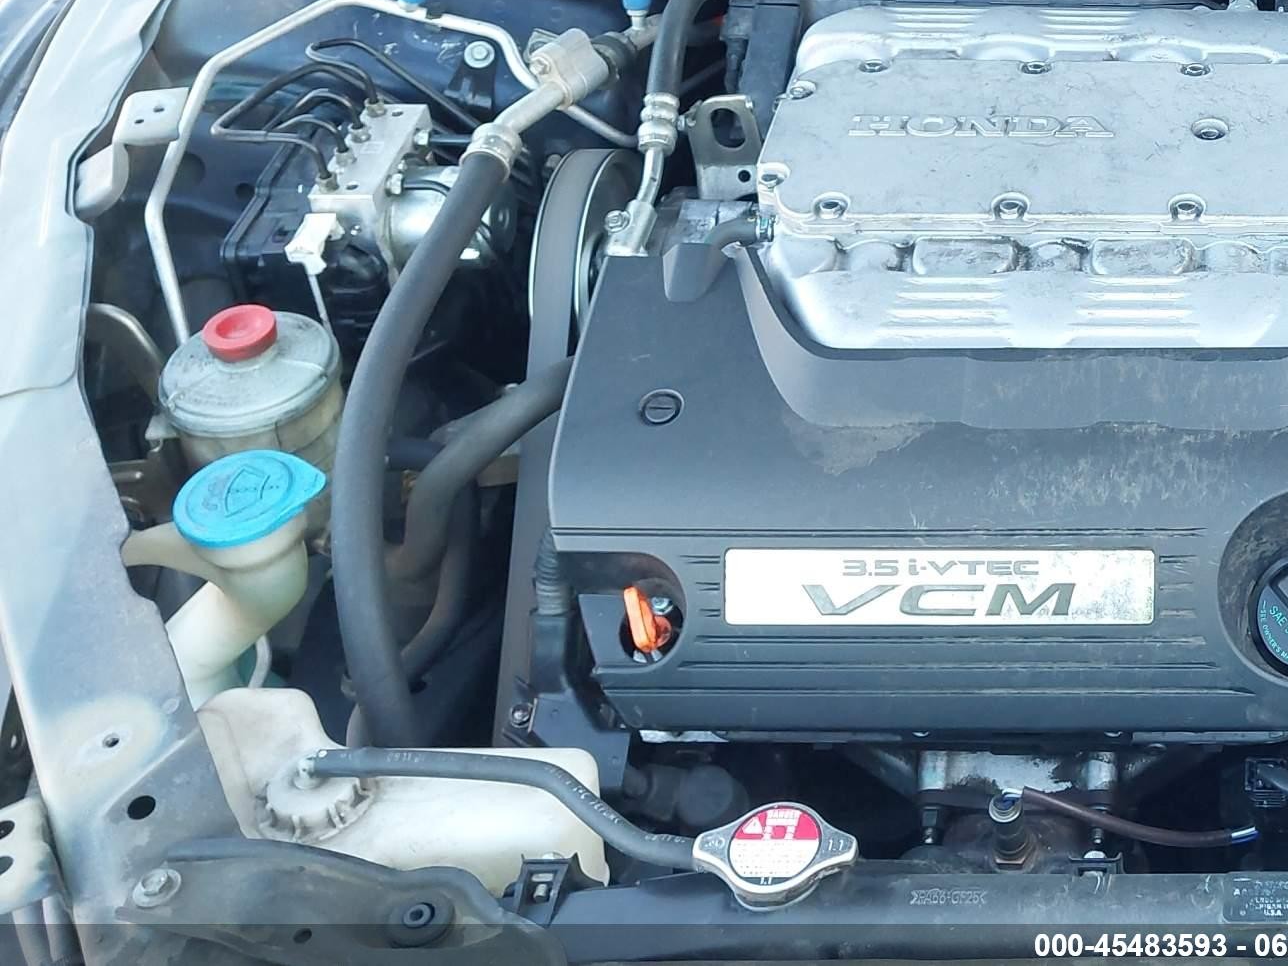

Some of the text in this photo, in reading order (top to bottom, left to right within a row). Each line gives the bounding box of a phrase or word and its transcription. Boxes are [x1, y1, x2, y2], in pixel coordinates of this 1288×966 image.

[848, 114, 1114, 138] HONDA
[842, 558, 1039, 576] 3.5 i-VTEC
[802, 583, 1076, 617] VCM
[1269, 605, 1288, 626] SAE
